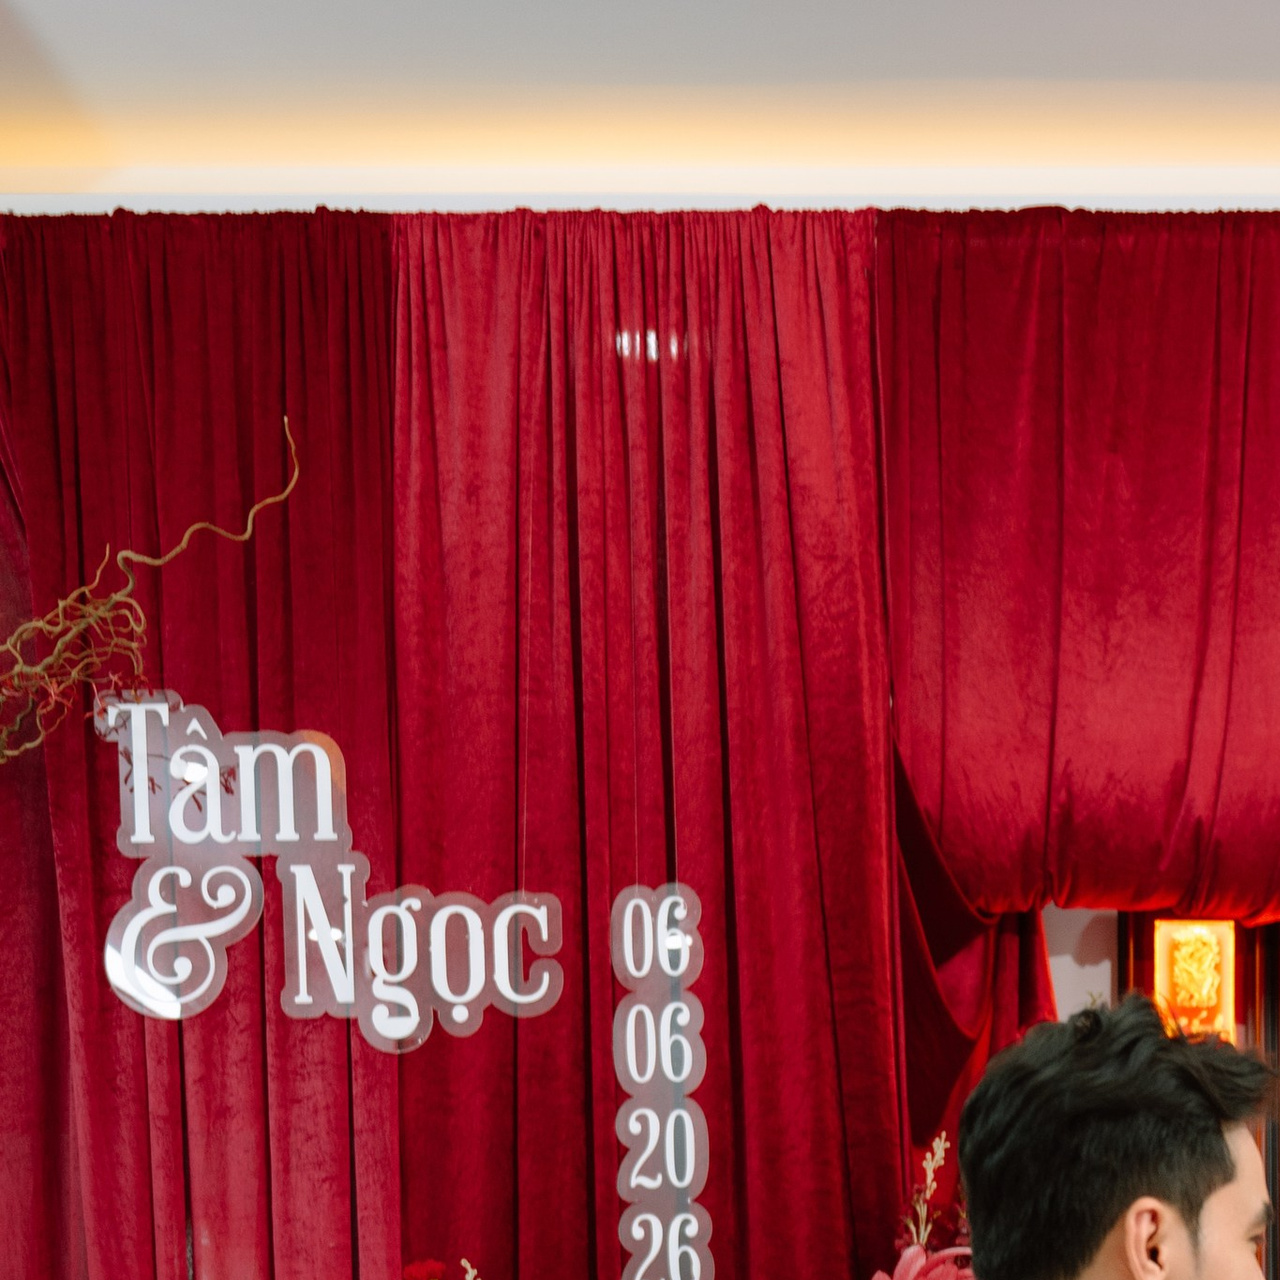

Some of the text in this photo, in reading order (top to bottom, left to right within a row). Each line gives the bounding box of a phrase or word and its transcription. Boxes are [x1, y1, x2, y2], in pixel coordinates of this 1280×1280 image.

[107, 702, 339, 844] Tâm
[121, 863, 551, 1039] & Ngọc
[622, 895, 693, 978] 06
[625, 1001, 693, 1084] 06
[628, 1107, 696, 1190] 20
